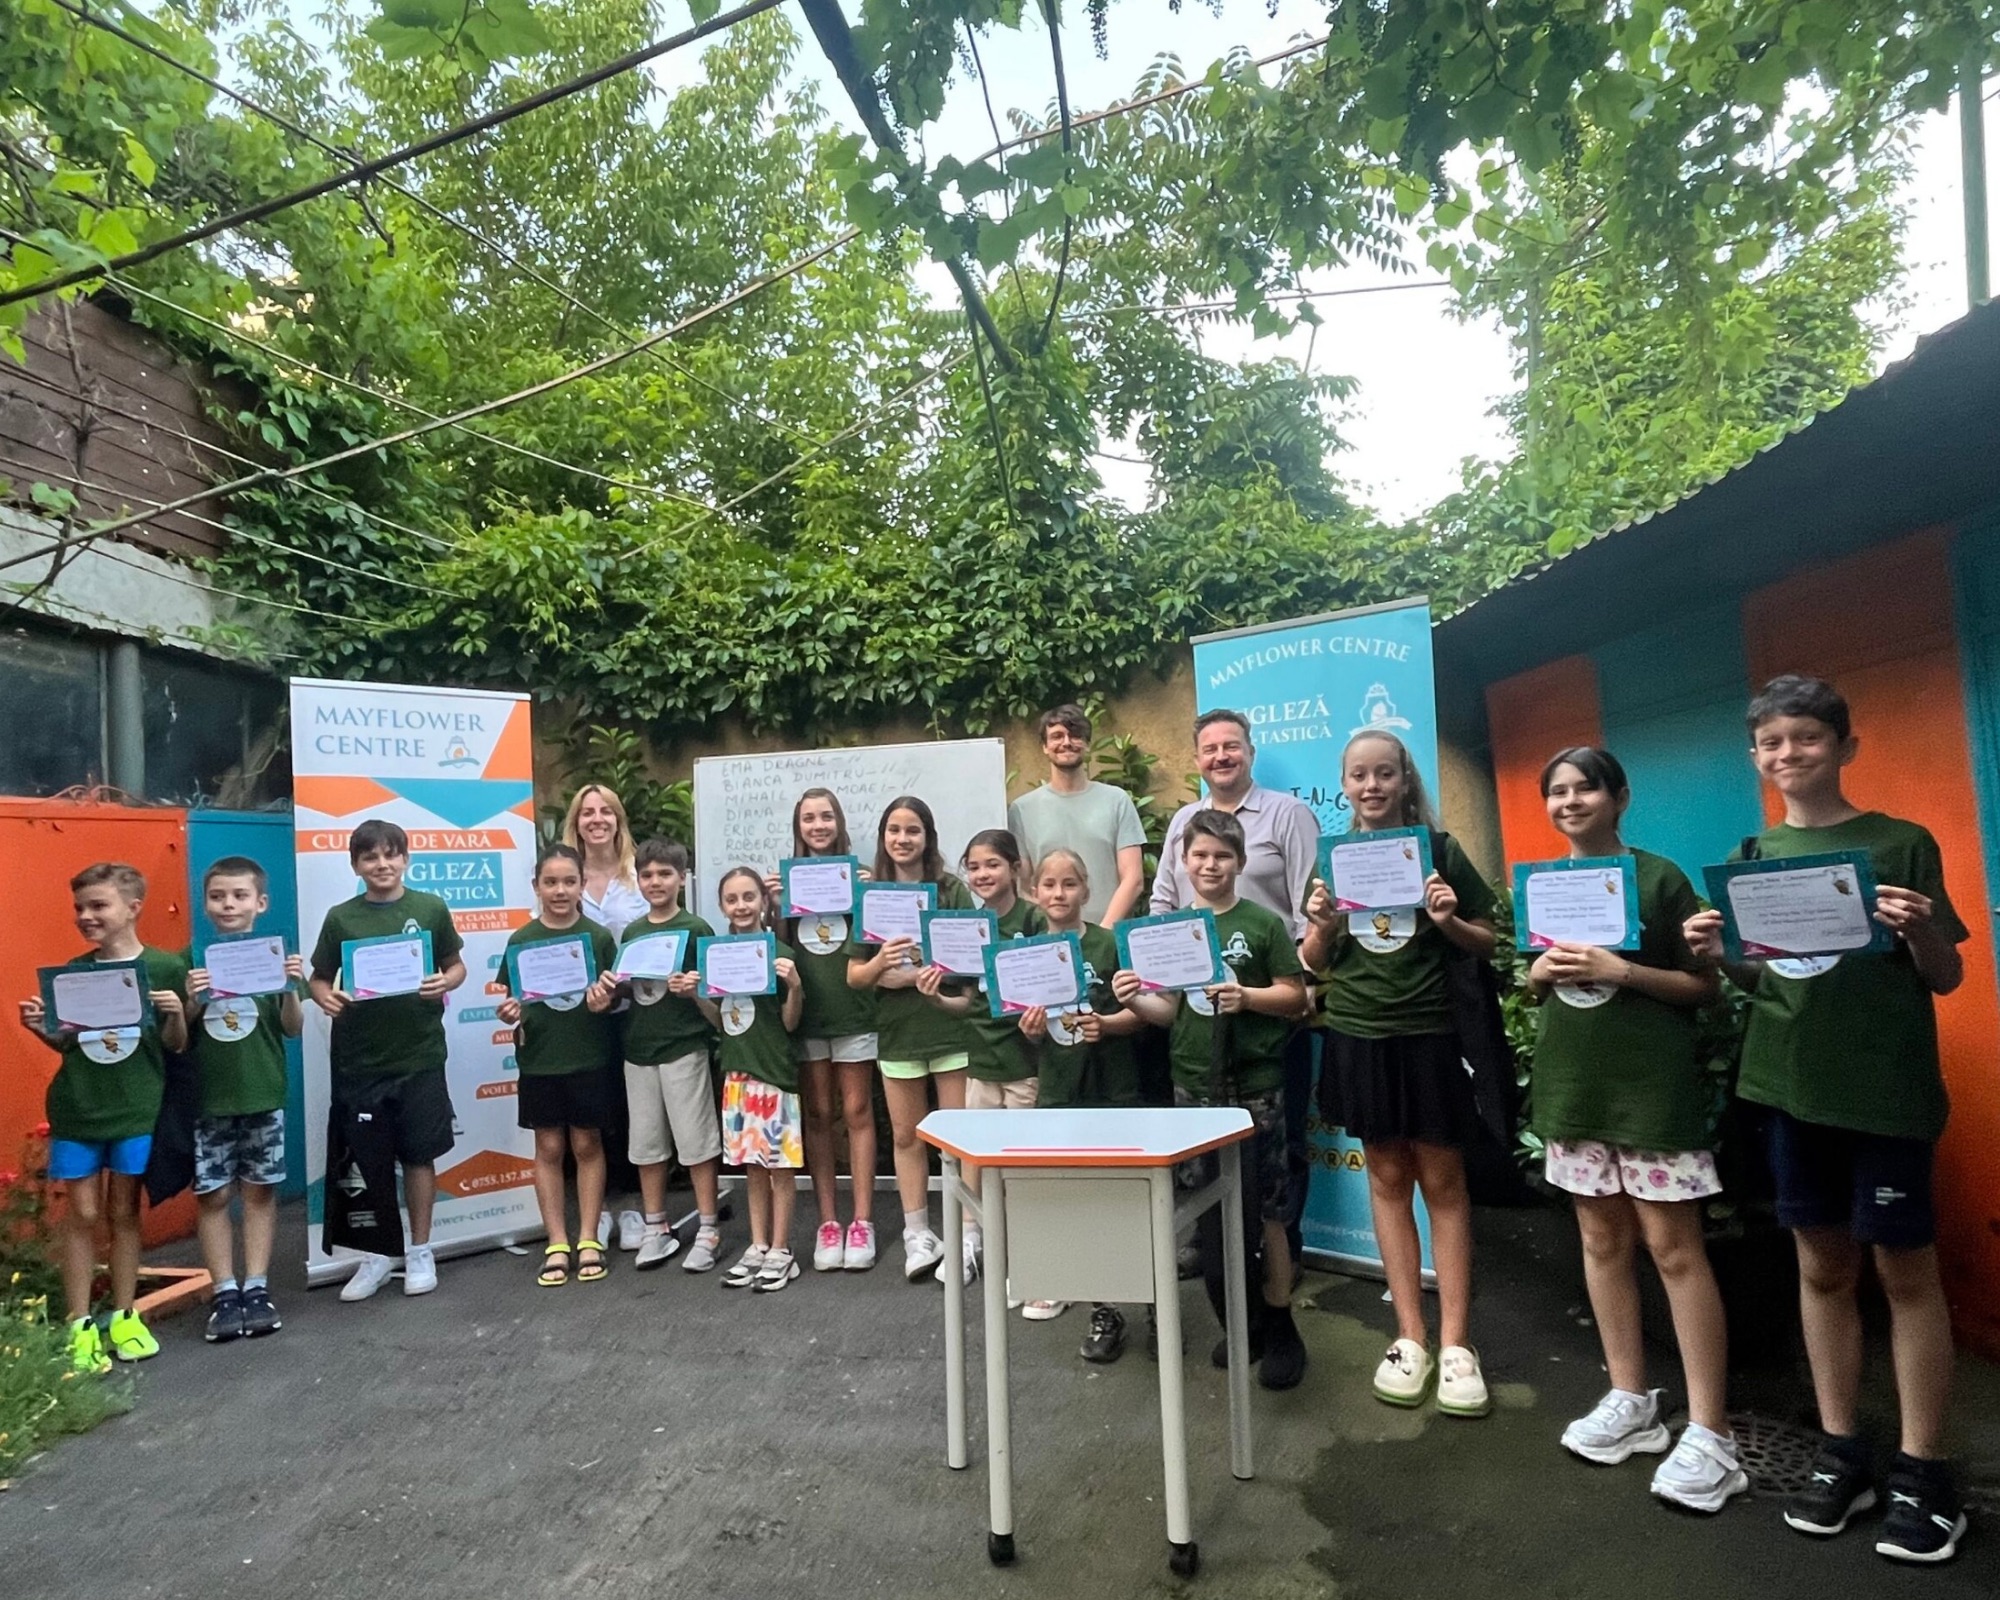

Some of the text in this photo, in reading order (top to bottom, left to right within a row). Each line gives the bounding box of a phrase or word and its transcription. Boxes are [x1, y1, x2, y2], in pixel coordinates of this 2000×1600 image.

[1209, 636, 1412, 689] MAYFLOWER CENTRE
[314, 705, 485, 732] MAYFLOWER
[315, 734, 426, 758] CENTRE
[722, 762, 752, 778] EMA
[723, 775, 782, 793] BIANCA
[726, 806, 774, 822] DIANA
[412, 834, 438, 849] DE
[441, 831, 492, 849] VARĂ
[459, 920, 509, 931] AER LIBER
